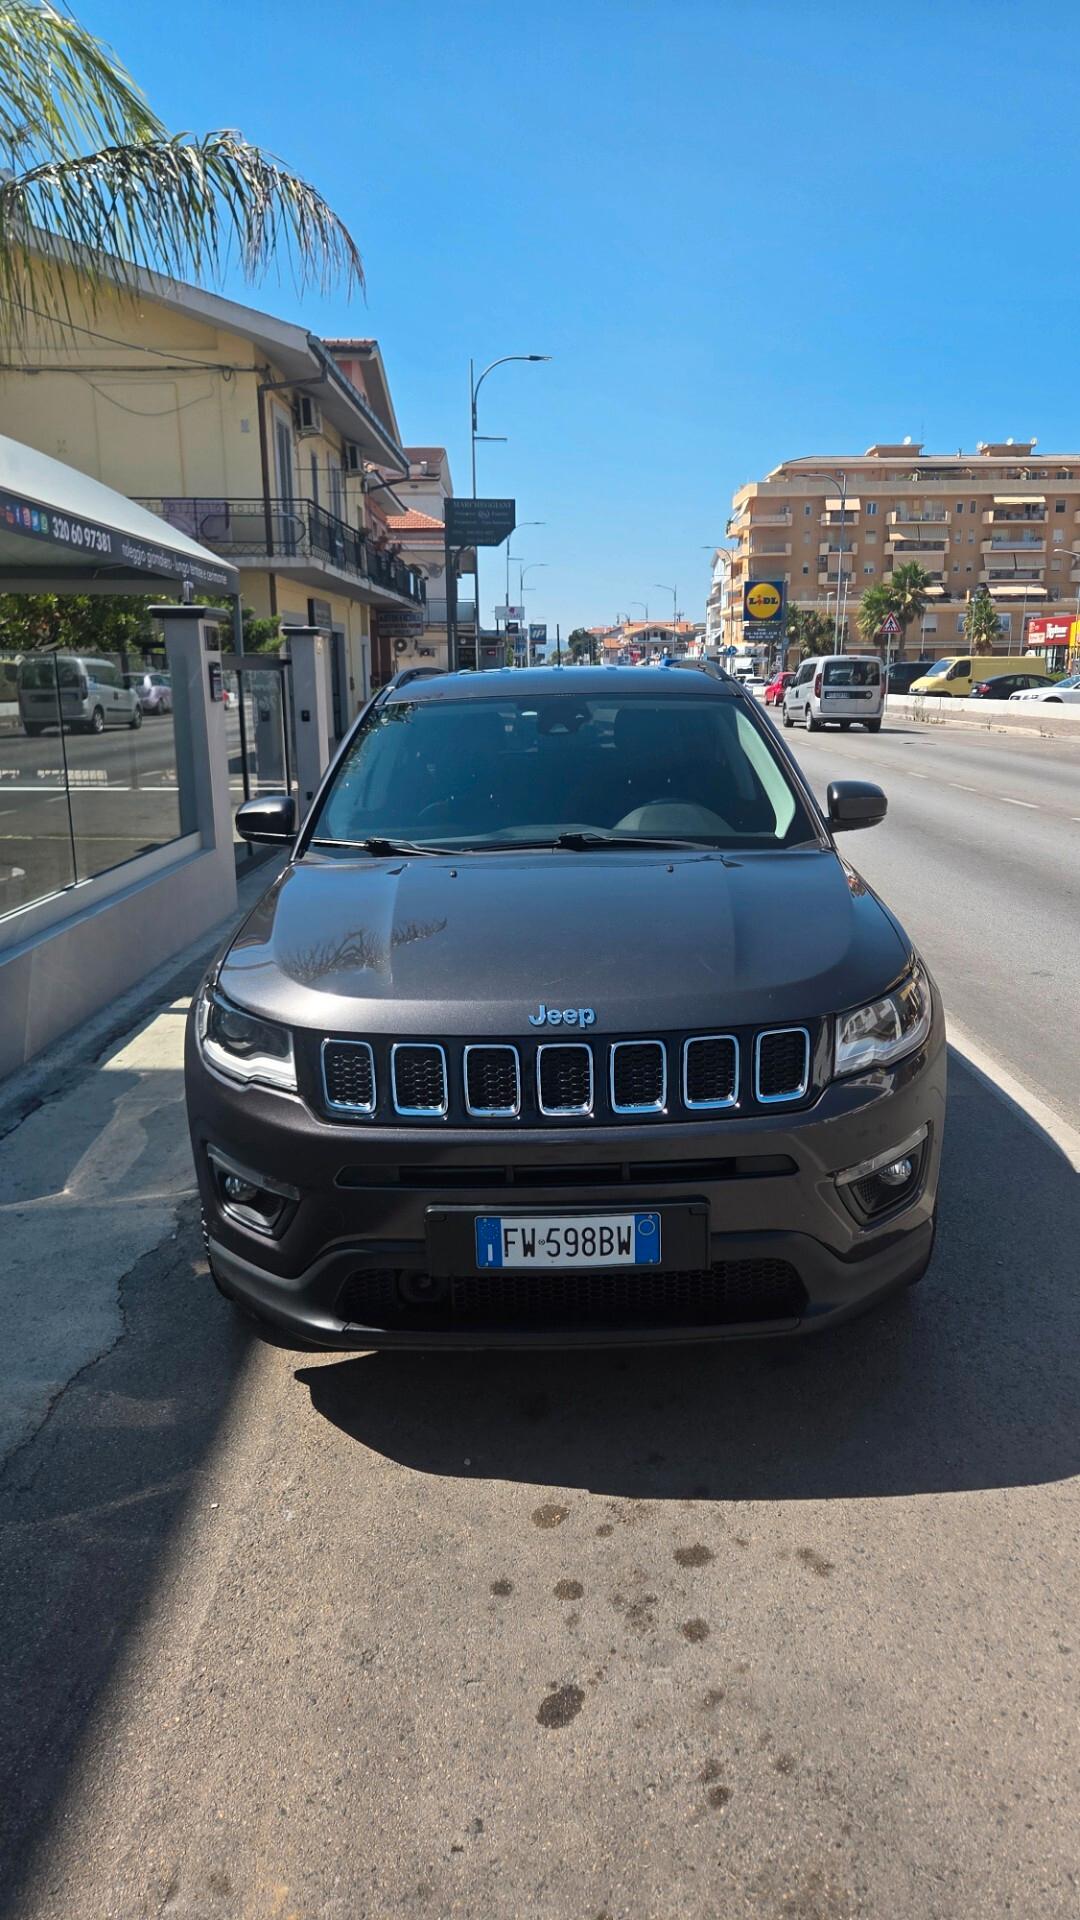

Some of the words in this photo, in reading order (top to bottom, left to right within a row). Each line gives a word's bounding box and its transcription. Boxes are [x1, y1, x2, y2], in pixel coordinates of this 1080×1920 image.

[52, 516, 70, 541] 320
[71, 523, 83, 545] 60
[84, 528, 112, 552] 97381
[528, 1004, 596, 1028] Jeep
